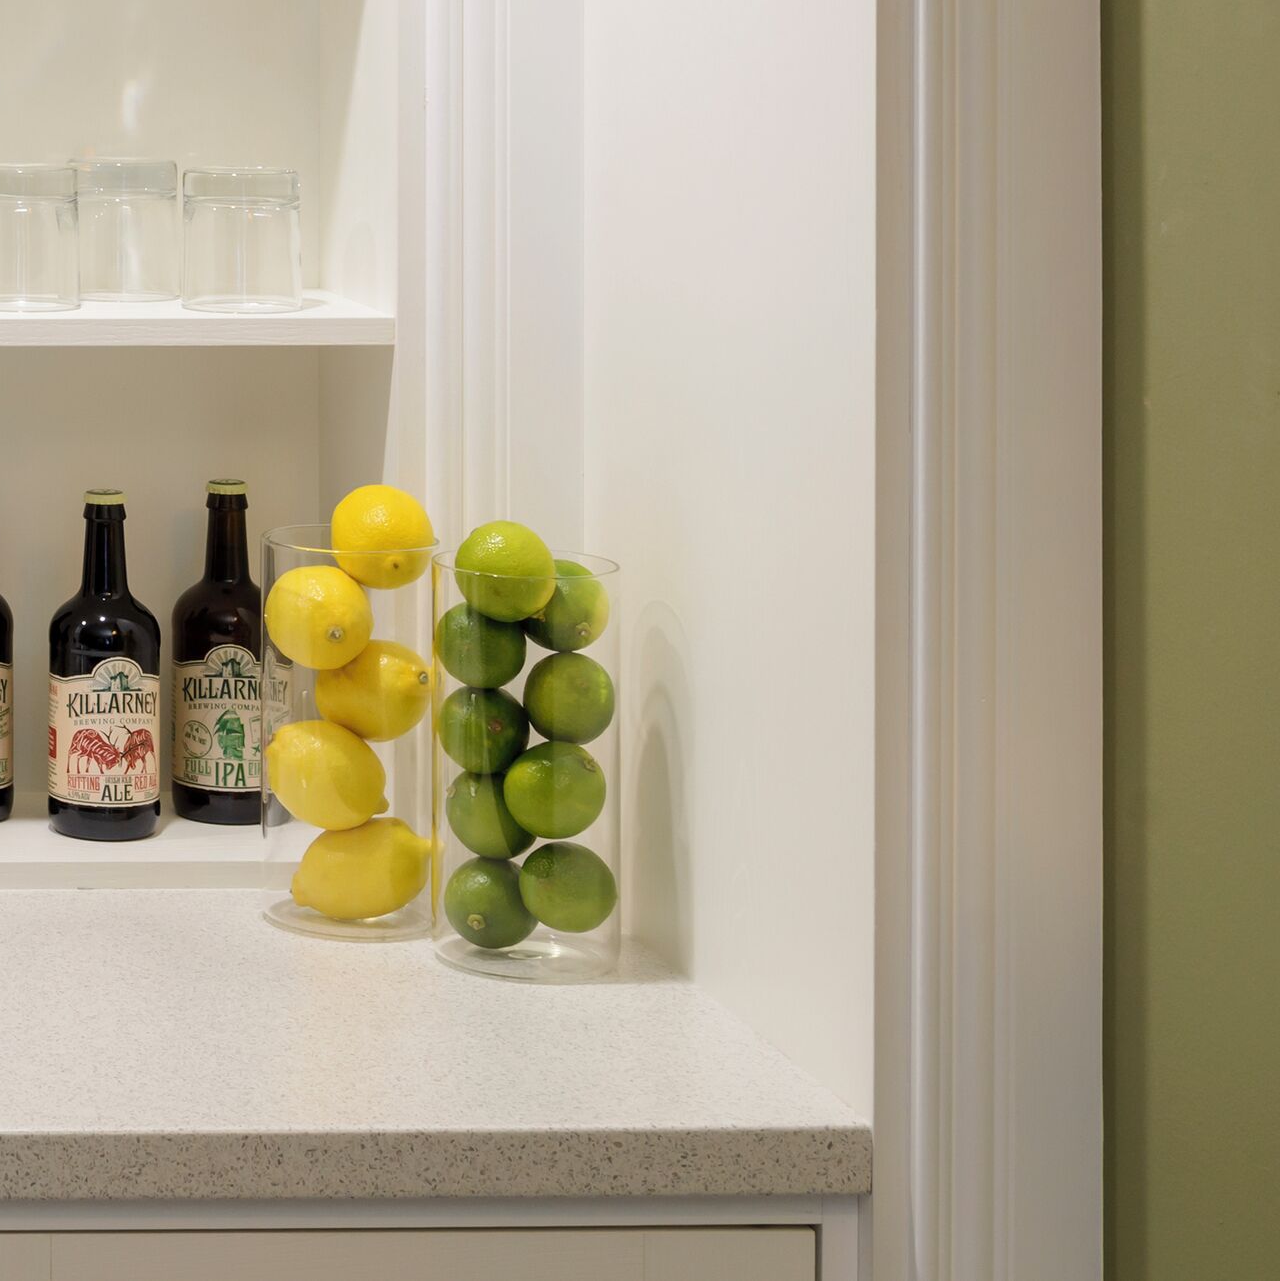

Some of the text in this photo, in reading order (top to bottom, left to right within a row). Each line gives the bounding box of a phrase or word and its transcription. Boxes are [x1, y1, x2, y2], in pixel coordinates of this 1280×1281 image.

[183, 678, 262, 701] KILLARN
[67, 692, 158, 718] KILLARNEY
[74, 718, 153, 726] BREWING COMPANY
[185, 760, 212, 775] FULL
[215, 762, 247, 787] IPA
[68, 776, 100, 791] RUTTING
[135, 776, 148, 790] RED
[102, 785, 134, 801] ALE
